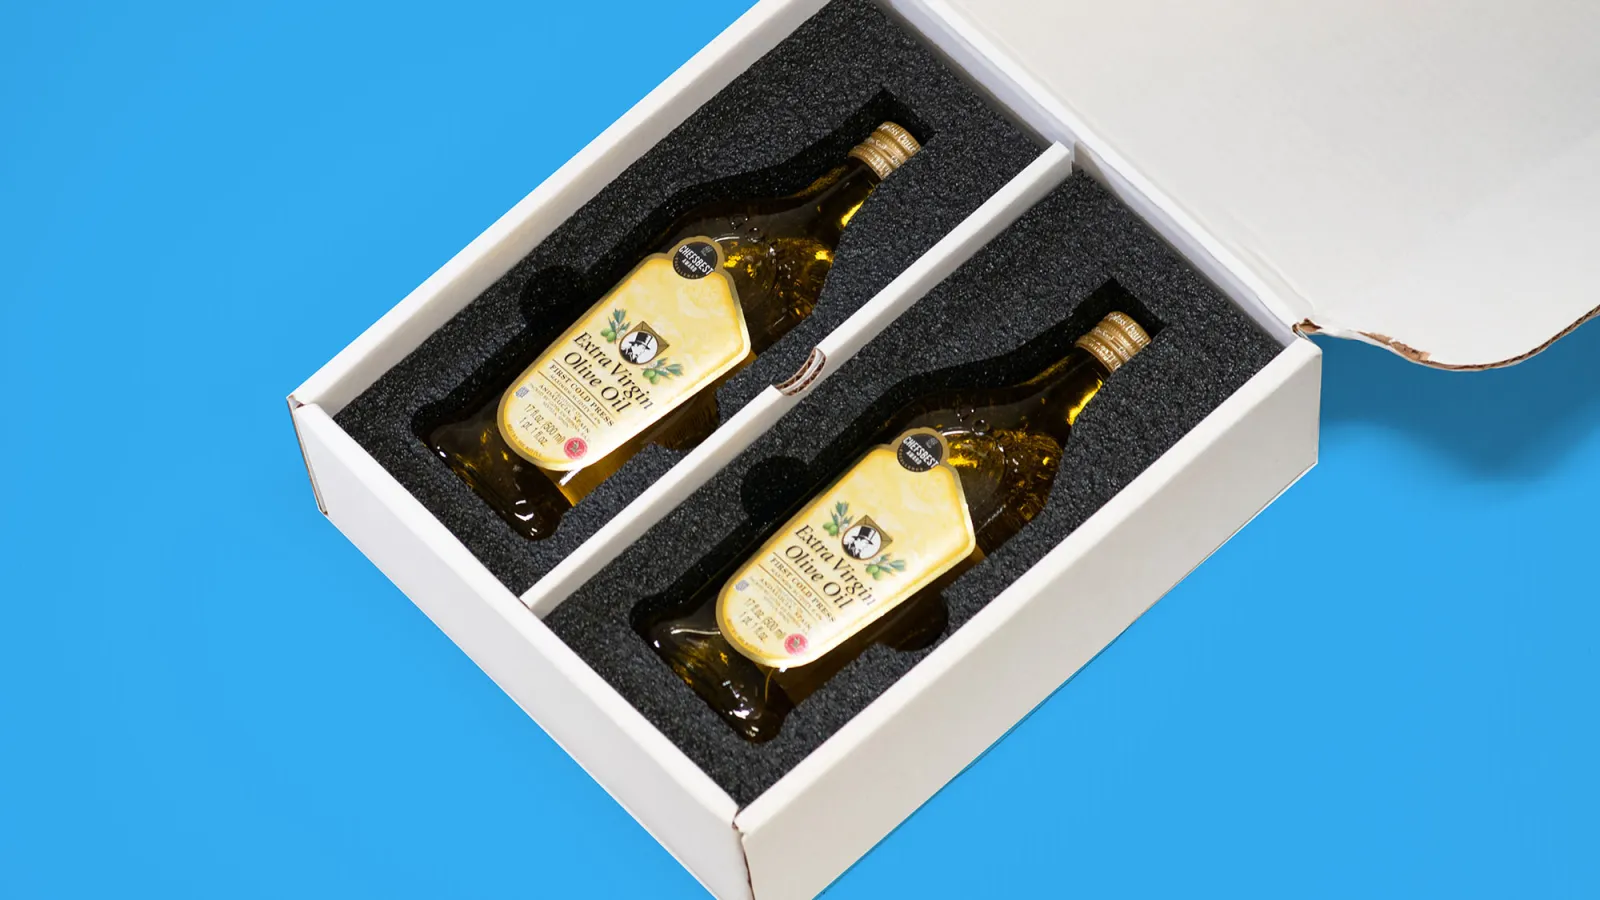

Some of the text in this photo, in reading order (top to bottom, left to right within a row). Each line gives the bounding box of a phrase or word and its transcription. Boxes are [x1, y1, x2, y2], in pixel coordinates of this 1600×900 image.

[679, 245, 714, 275] CHEFSBEST
[548, 363, 616, 427] FIRST COLD PRESS
[564, 352, 602, 387] Olive
[601, 386, 631, 412] Oil
[573, 332, 653, 409] Extra Virgin
[523, 403, 535, 413] 17
[572, 415, 591, 433] SPAIN
[903, 436, 939, 468] CHEFSBEST
[769, 557, 792, 578] FIRST
[790, 576, 813, 598] COLD
[809, 596, 838, 622] PRESS
[785, 545, 824, 581] Olive
[823, 582, 853, 608] Oil
[795, 525, 834, 562] Extra
[833, 557, 876, 606] Virgin
